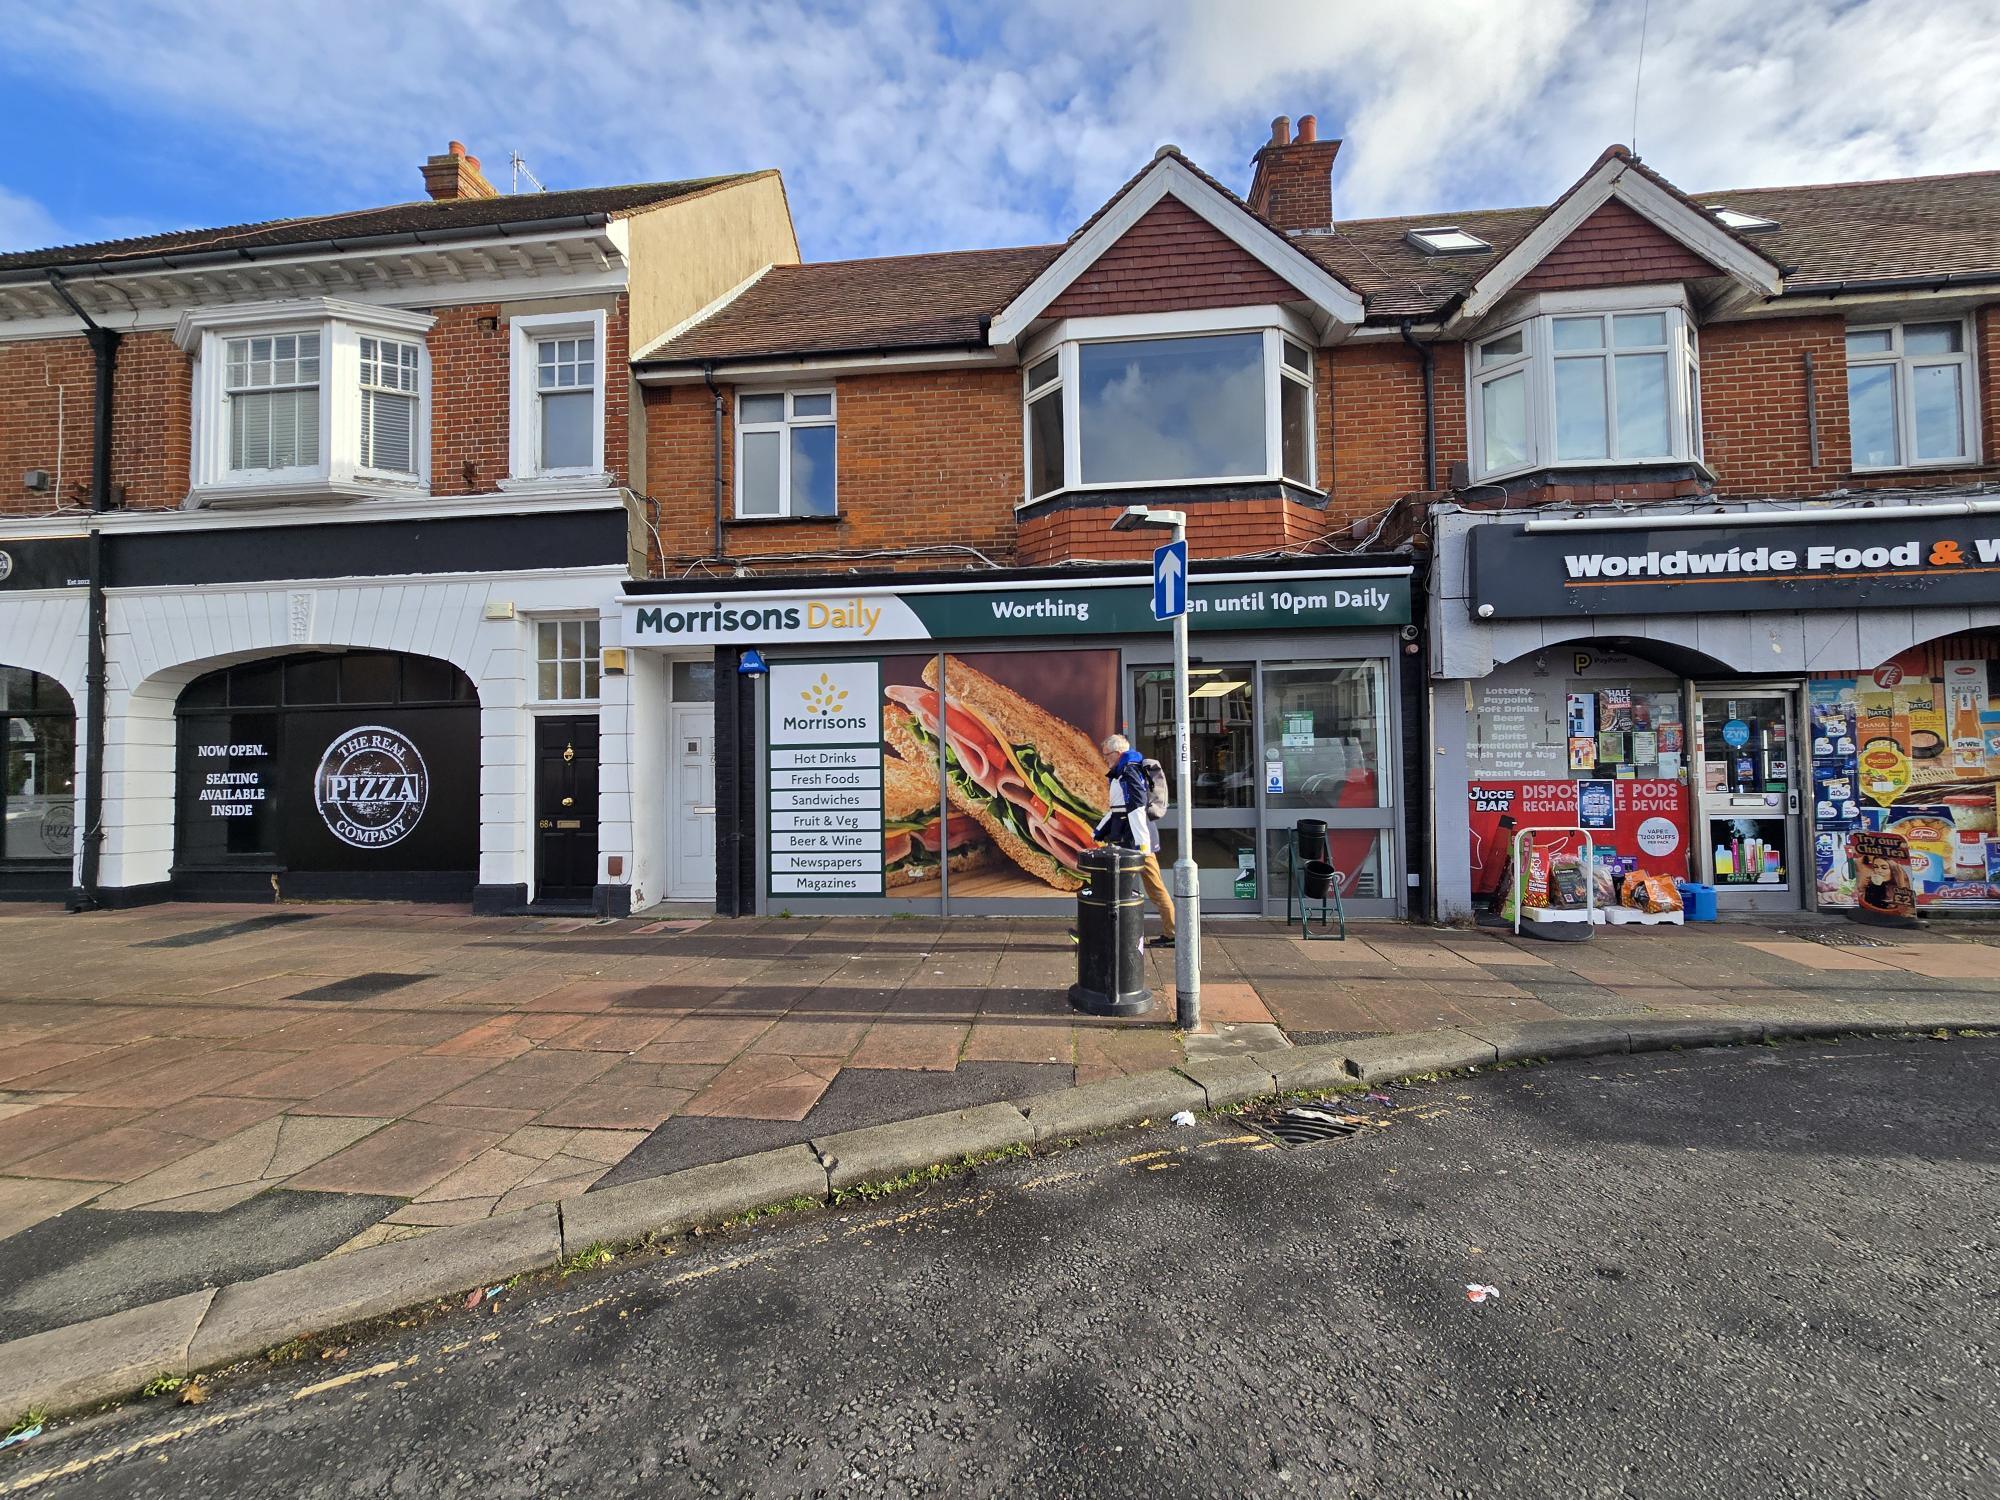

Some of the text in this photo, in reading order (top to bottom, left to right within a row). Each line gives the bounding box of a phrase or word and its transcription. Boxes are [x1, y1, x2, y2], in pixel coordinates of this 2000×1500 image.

[1565, 547, 1797, 577] Worldwide
[1808, 541, 1920, 569] Food
[1929, 540, 1964, 566] &
[992, 588, 1390, 620] Worthing en until 10pm Daily
[636, 598, 881, 636] Morrisons Daily
[1608, 689, 1631, 697] HALF
[1483, 696, 1533, 704] Paypoint
[1478, 705, 1540, 713] Soft Drinks
[783, 711, 866, 730] Morrisons
[198, 745, 228, 757] NOW
[337, 735, 407, 760] THE REAL
[794, 752, 857, 764] Hot Drinks
[1496, 751, 1523, 759] Fruit
[1525, 751, 1533, 759] &
[1535, 751, 1557, 759] Veg
[206, 772, 259, 785] SEATING
[791, 772, 860, 785] Fresh Foods
[1513, 769, 1546, 777] Foods
[199, 788, 265, 800] AVAILABLE
[329, 777, 417, 801] PIZZA
[1522, 783, 1678, 798] DISPOSE PODS
[792, 793, 860, 806] Sandwiches
[1476, 800, 1509, 811] BAR
[1632, 800, 1678, 811] DEVICE
[210, 804, 253, 816] INSIDE
[793, 815, 859, 829] Fruit & Veg
[46, 825, 74, 838] PIZZ
[336, 818, 406, 842] COMPANY
[790, 835, 863, 847] Beer & Wine
[1857, 834, 1900, 846] Try our
[1856, 844, 1906, 857] Chai Tea
[790, 856, 863, 870] Newspapers
[796, 877, 857, 891] Magazines
